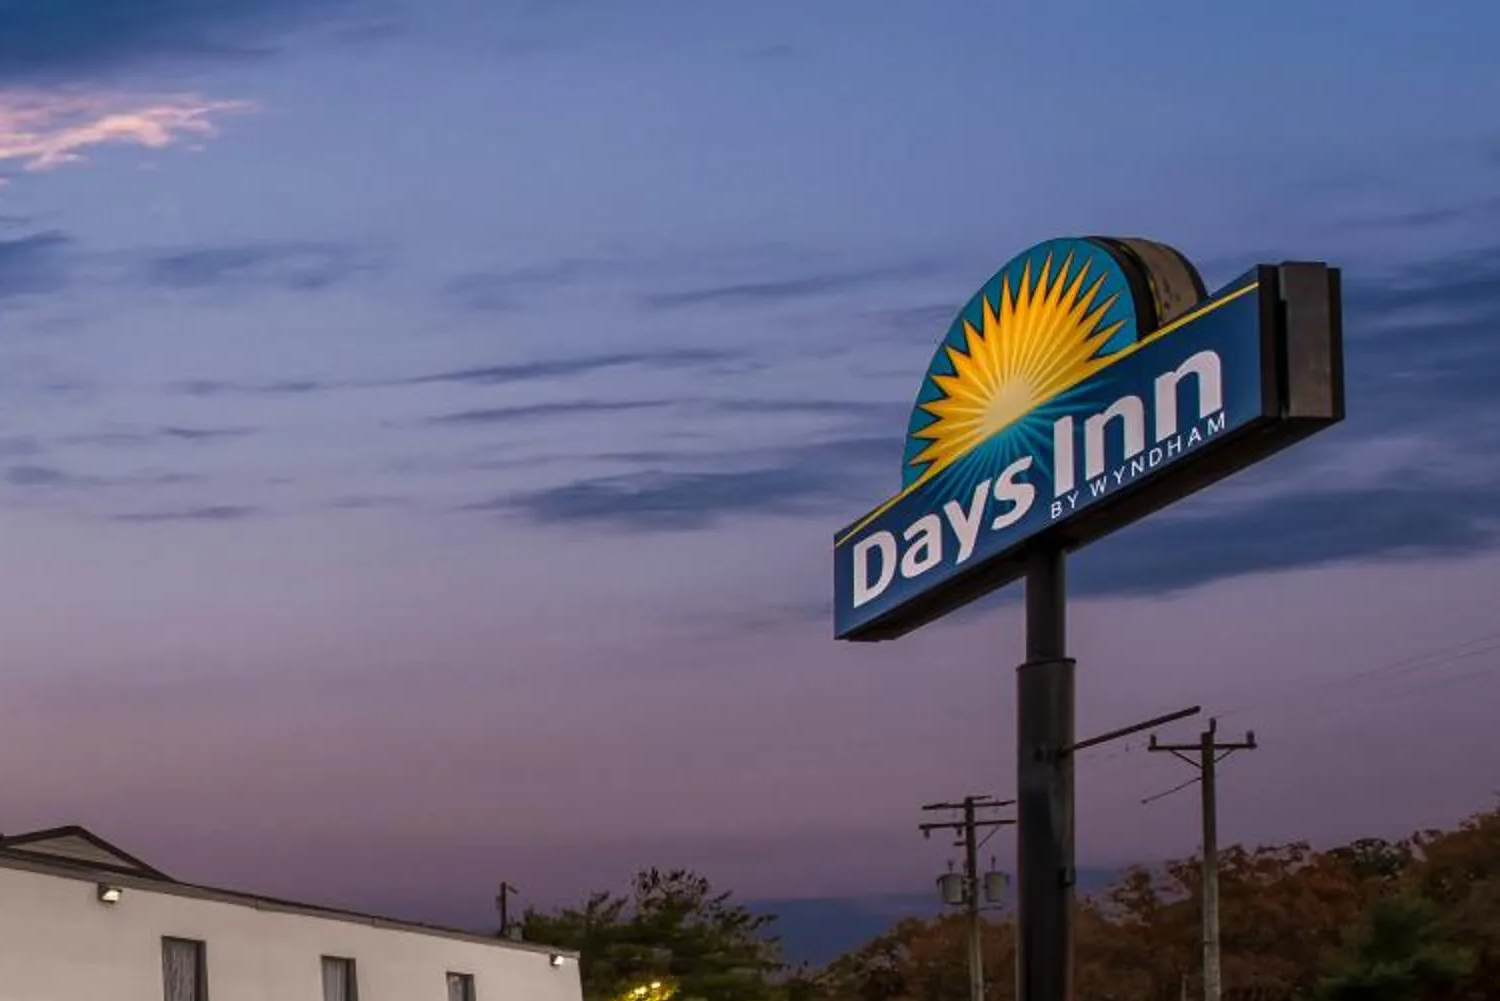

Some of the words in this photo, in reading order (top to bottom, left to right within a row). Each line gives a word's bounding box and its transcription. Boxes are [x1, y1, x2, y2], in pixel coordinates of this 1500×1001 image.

[852, 455, 1034, 609] Days
[1053, 349, 1223, 497] Inn
[1051, 491, 1079, 519] BY
[1091, 411, 1225, 497] WYNDHAM
